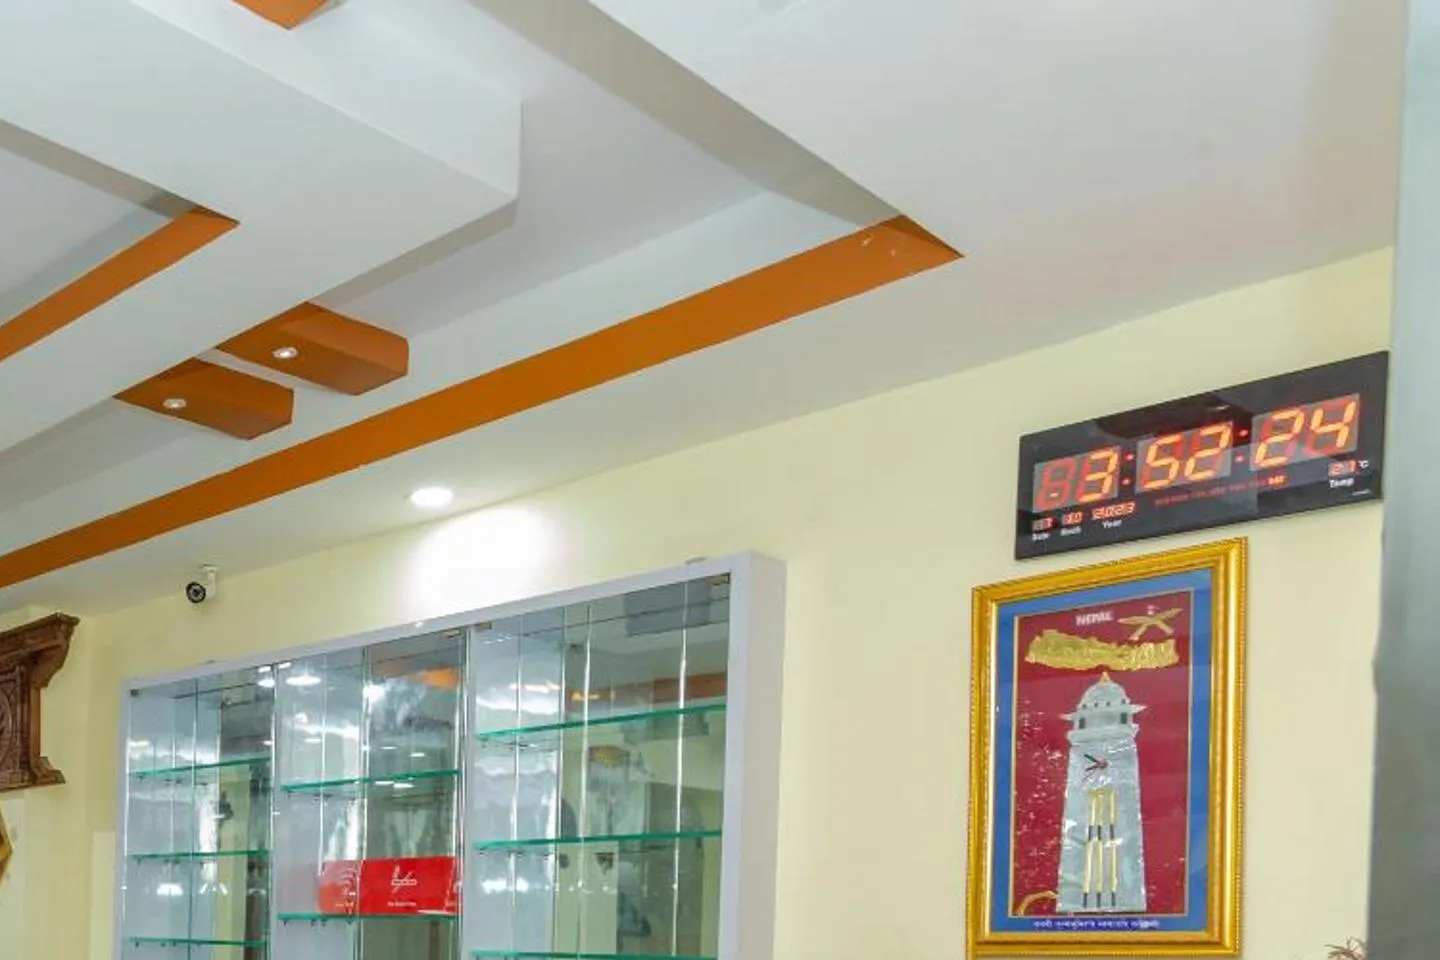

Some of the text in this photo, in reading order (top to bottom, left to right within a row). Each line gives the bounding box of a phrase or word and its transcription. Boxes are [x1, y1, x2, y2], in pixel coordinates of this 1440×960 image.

[1328, 478, 1355, 489] Temp
[1092, 502, 1136, 520] 2023
[1075, 611, 1114, 626] NEPAL
